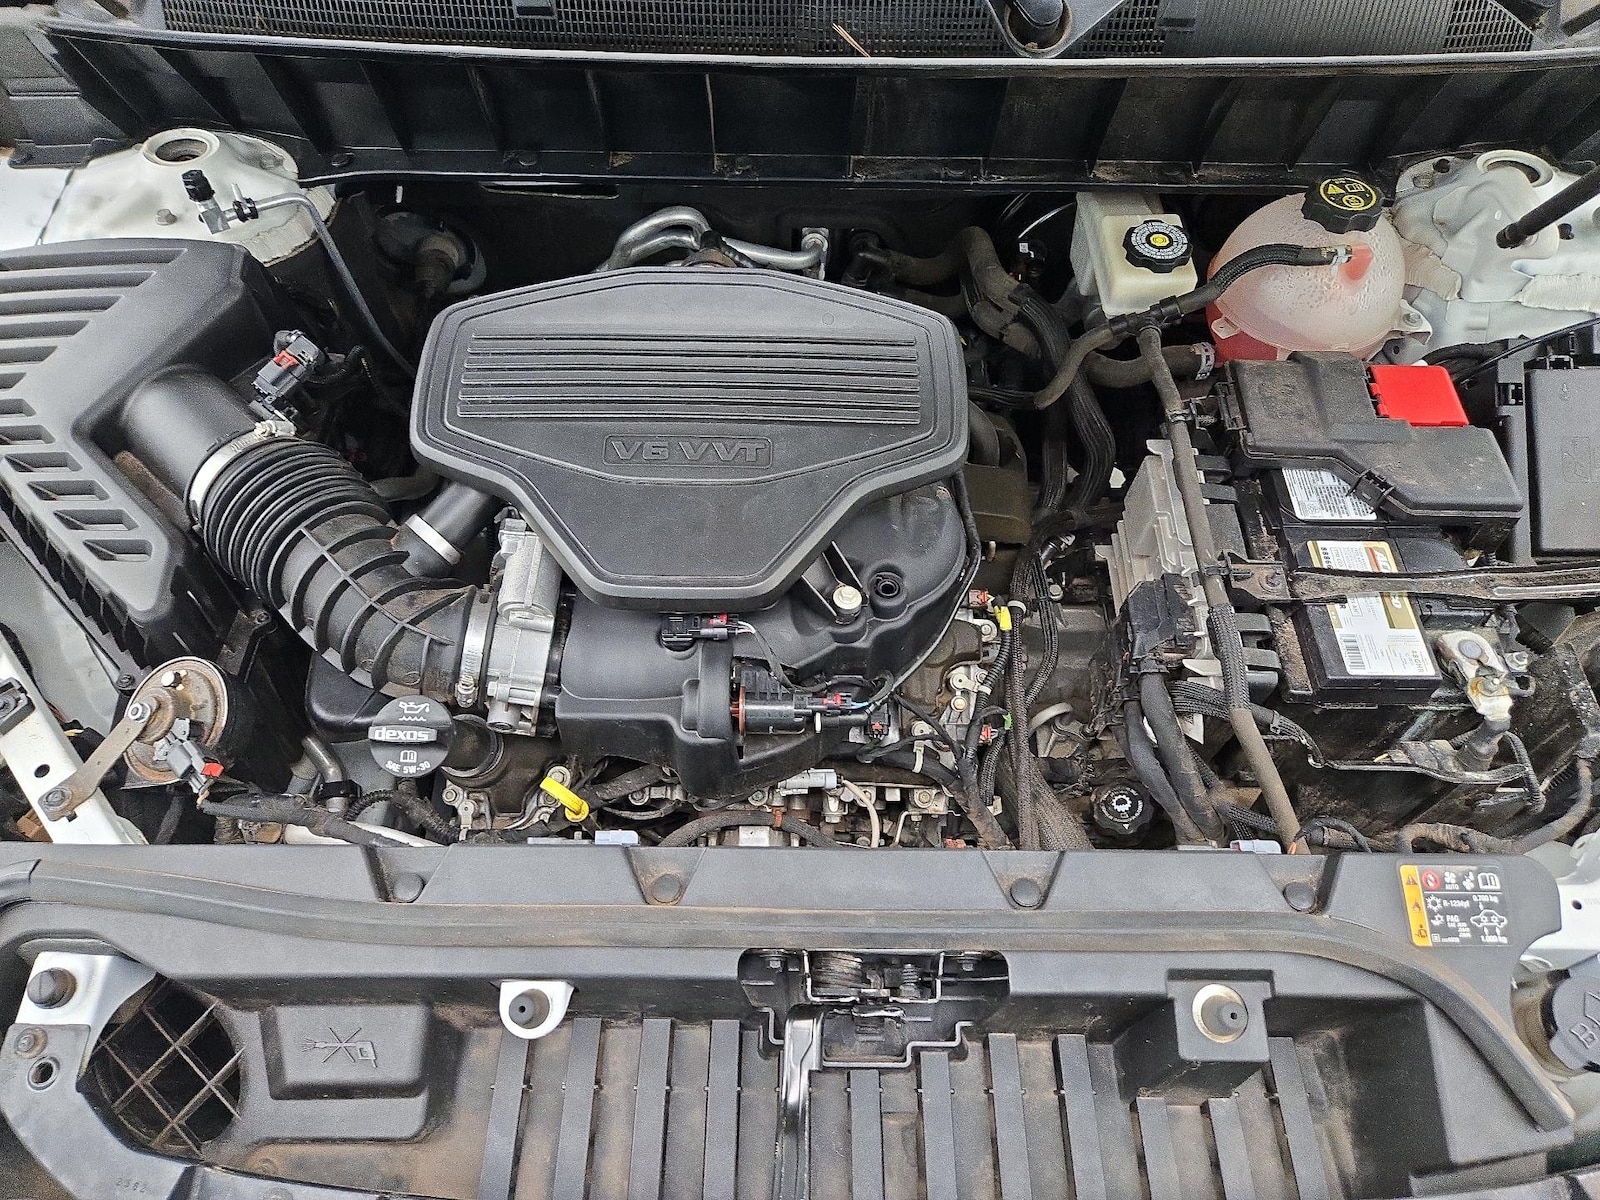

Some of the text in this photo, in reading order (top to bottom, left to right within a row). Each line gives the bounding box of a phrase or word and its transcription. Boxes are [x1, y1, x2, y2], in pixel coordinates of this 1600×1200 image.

[611, 441, 767, 462] V6 VVT
[375, 727, 430, 741] dexos
[385, 760, 431, 774] SAE 5W-30
